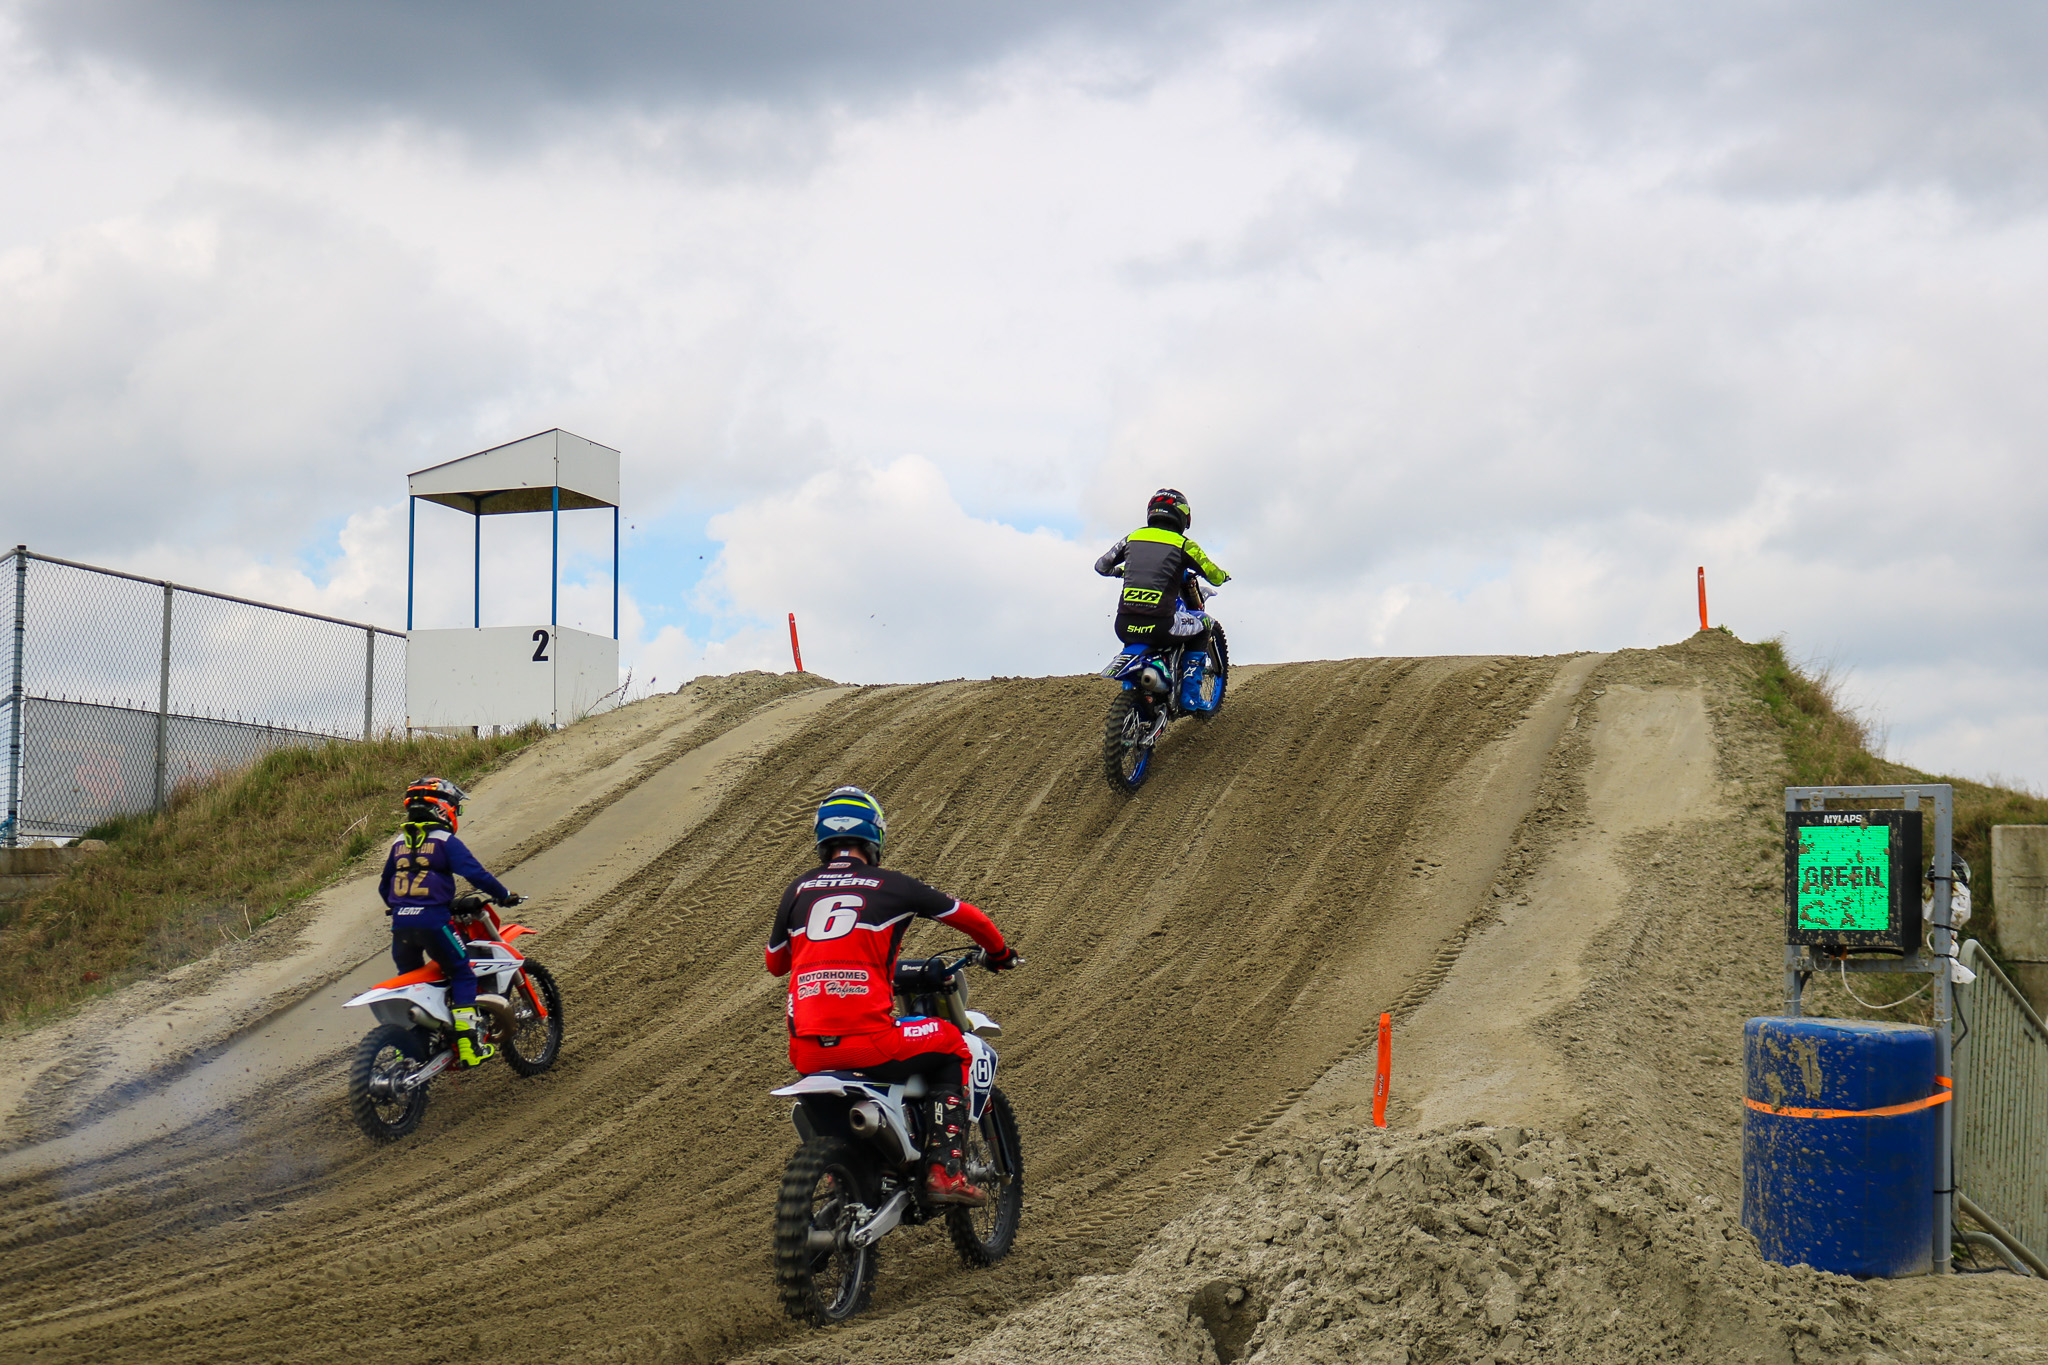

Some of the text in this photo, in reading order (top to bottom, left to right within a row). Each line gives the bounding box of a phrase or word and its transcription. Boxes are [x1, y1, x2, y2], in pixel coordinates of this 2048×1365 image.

[1125, 590, 1160, 602] FXR
[1127, 624, 1156, 634] SHOT
[532, 629, 550, 662] 2
[1823, 814, 1862, 824] MYLAPS
[1805, 866, 1880, 887] GREEN
[806, 894, 864, 941] 6
[798, 971, 868, 984] MOTORHOMES
[798, 981, 868, 999] Dirk Hofman
[903, 1022, 940, 1038] KENNY
